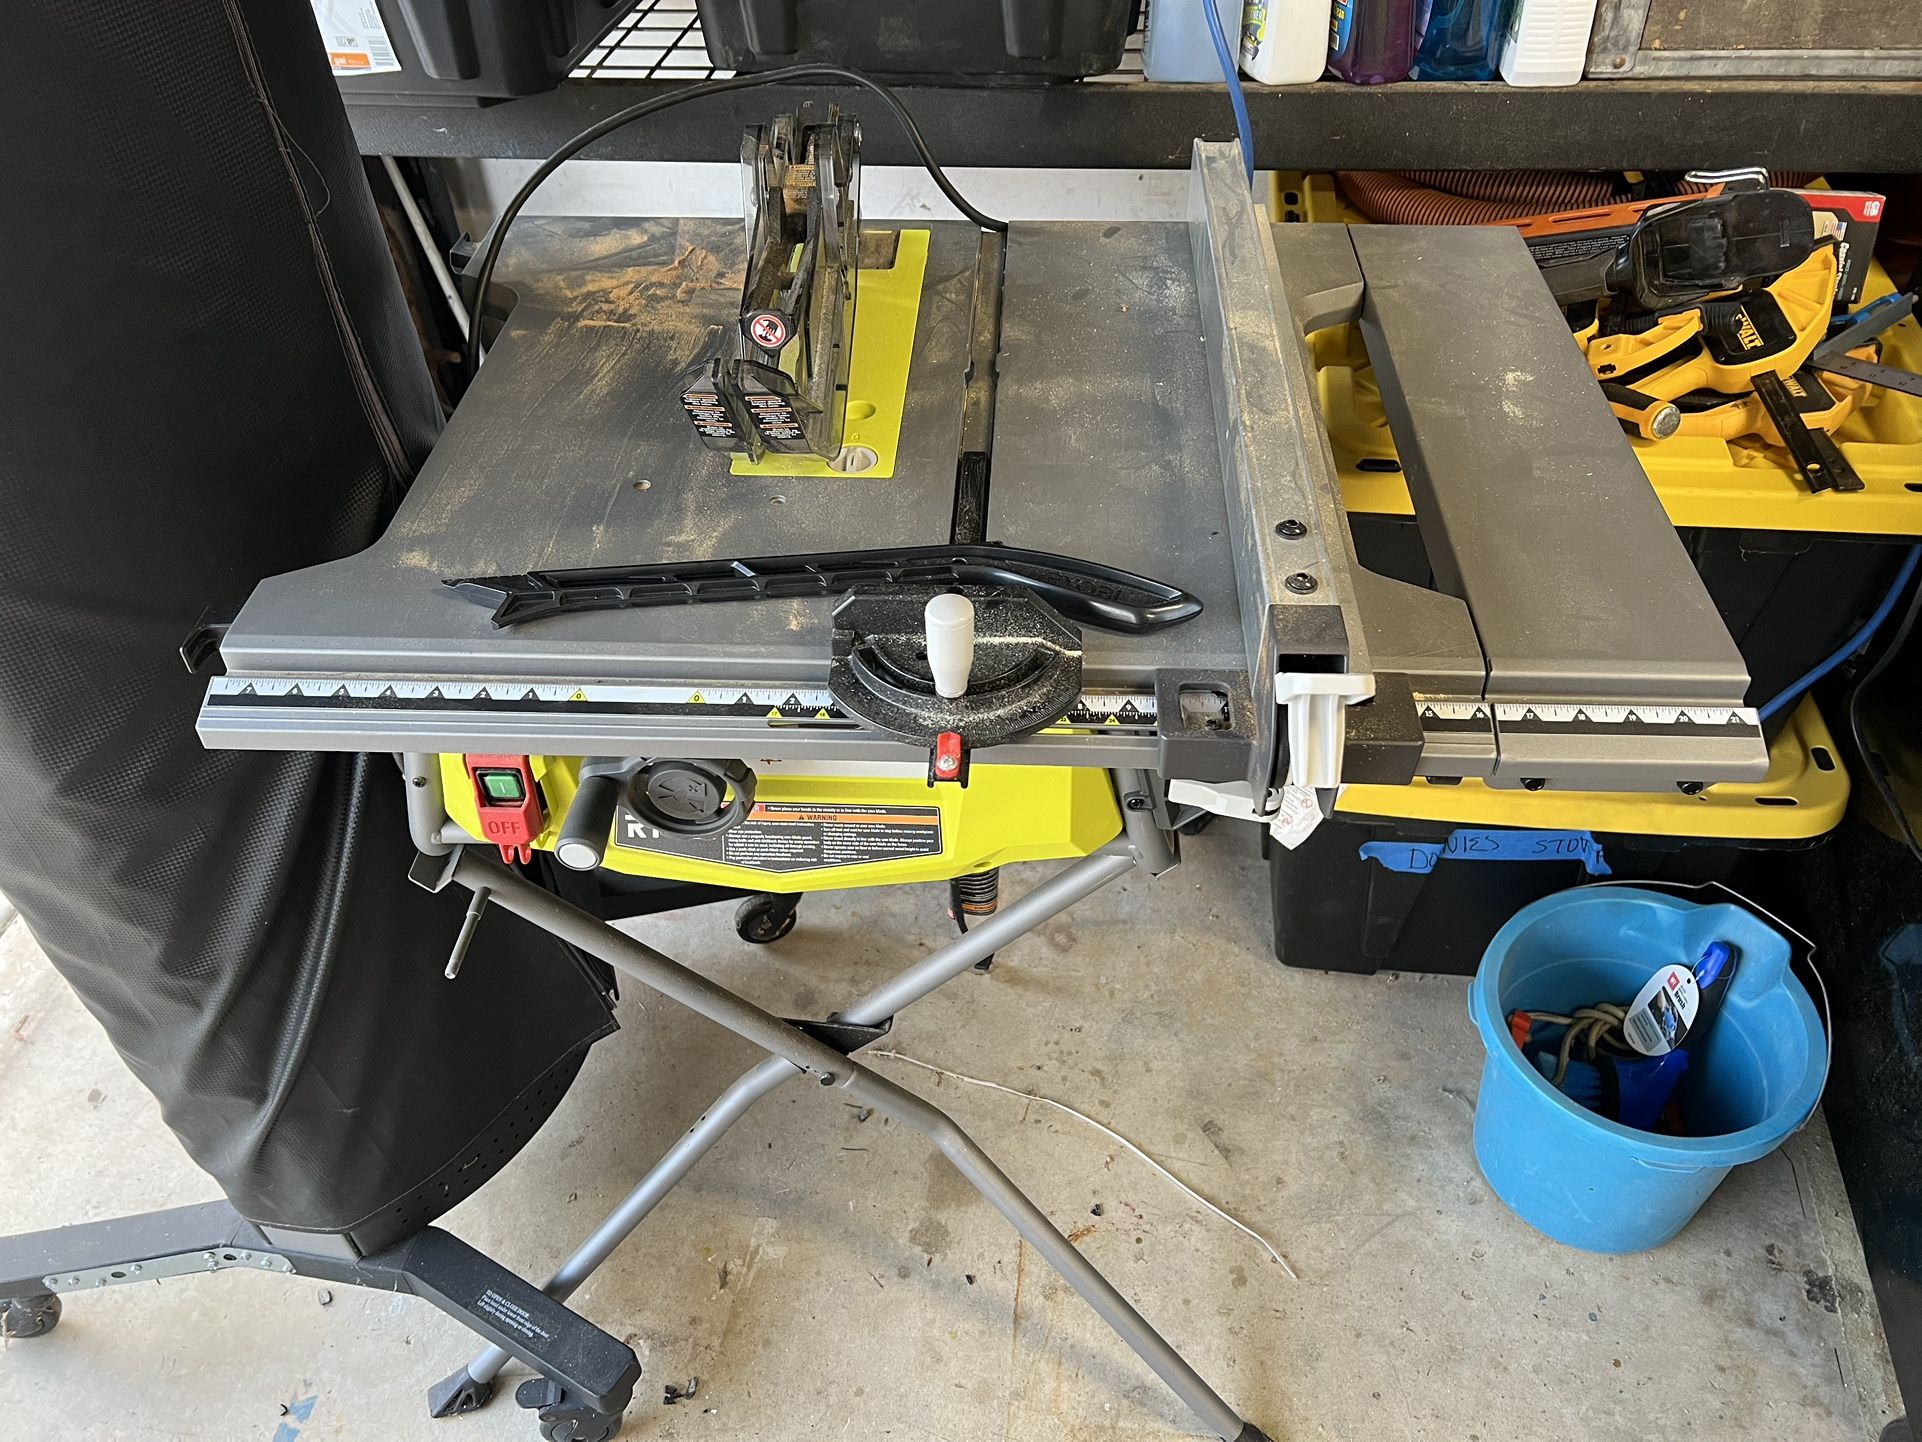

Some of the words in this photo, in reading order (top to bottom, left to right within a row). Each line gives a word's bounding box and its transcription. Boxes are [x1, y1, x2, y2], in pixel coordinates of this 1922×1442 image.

[291, 687, 298, 695] 6
[742, 695, 747, 703] 1
[1525, 712, 1534, 720] 17
[1577, 713, 1586, 721] 18
[1628, 714, 1637, 722] 19
[1678, 715, 1689, 723] 20
[805, 814, 837, 822] WARNING
[488, 821, 521, 835] OFF
